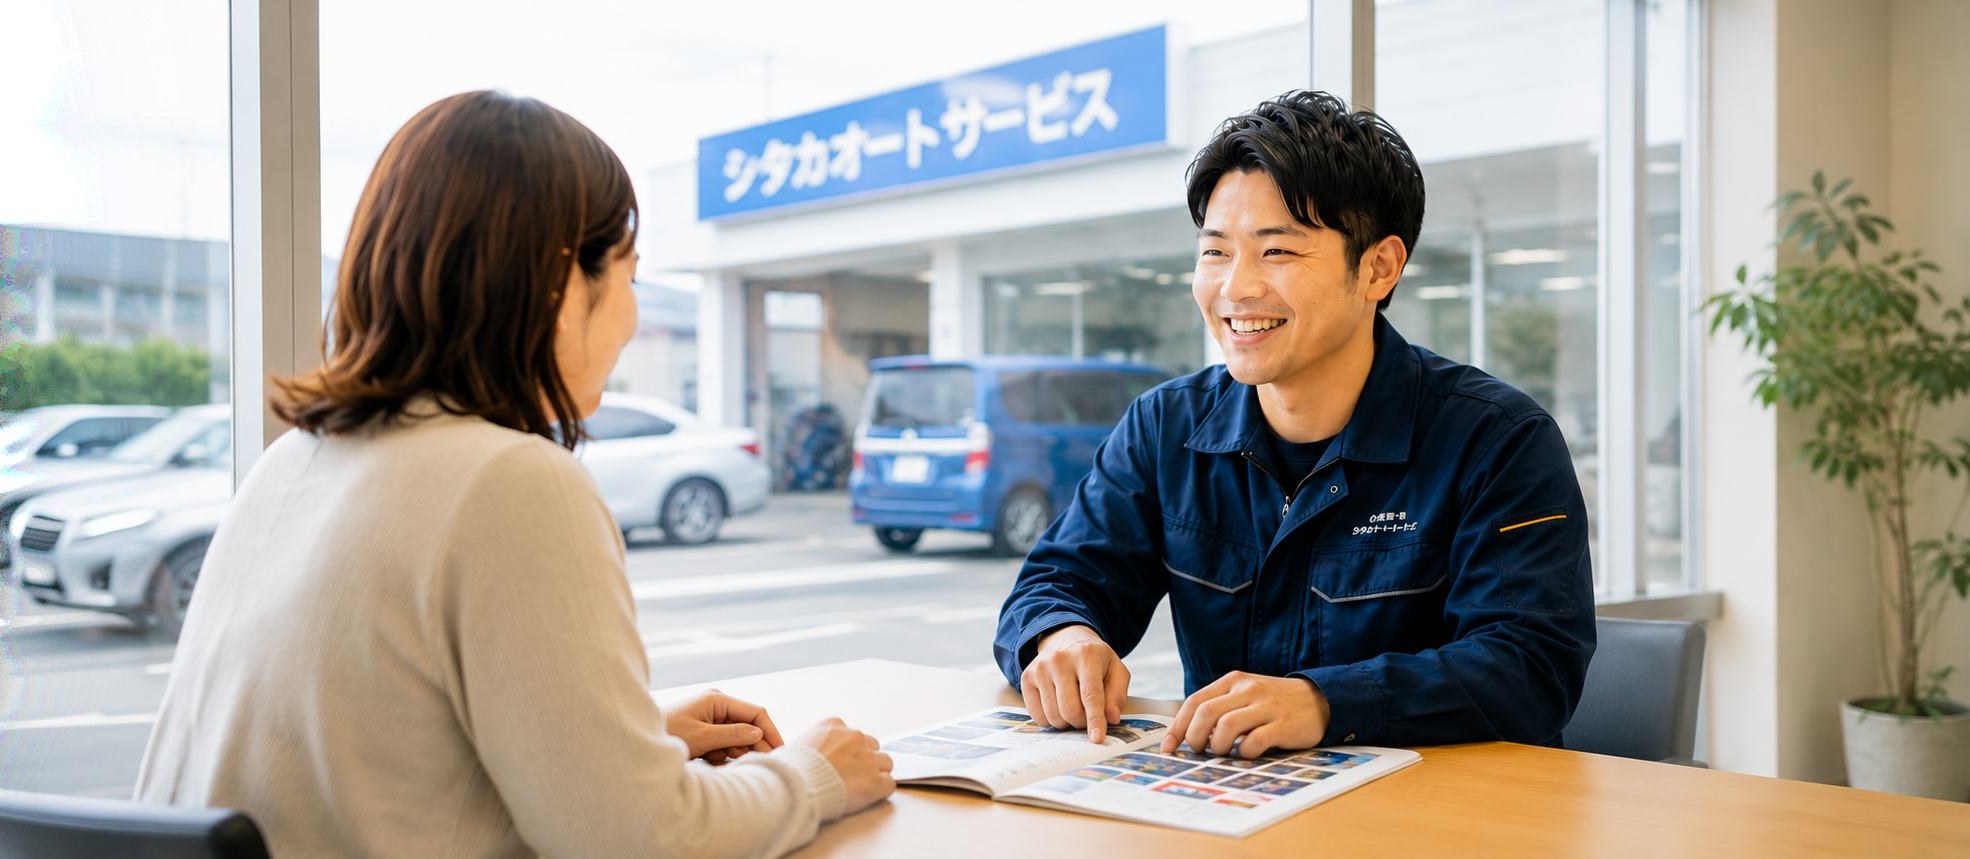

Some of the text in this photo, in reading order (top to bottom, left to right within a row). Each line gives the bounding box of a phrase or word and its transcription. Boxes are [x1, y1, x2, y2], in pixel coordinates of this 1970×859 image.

[723, 68, 1119, 203] シタカオートサービス
